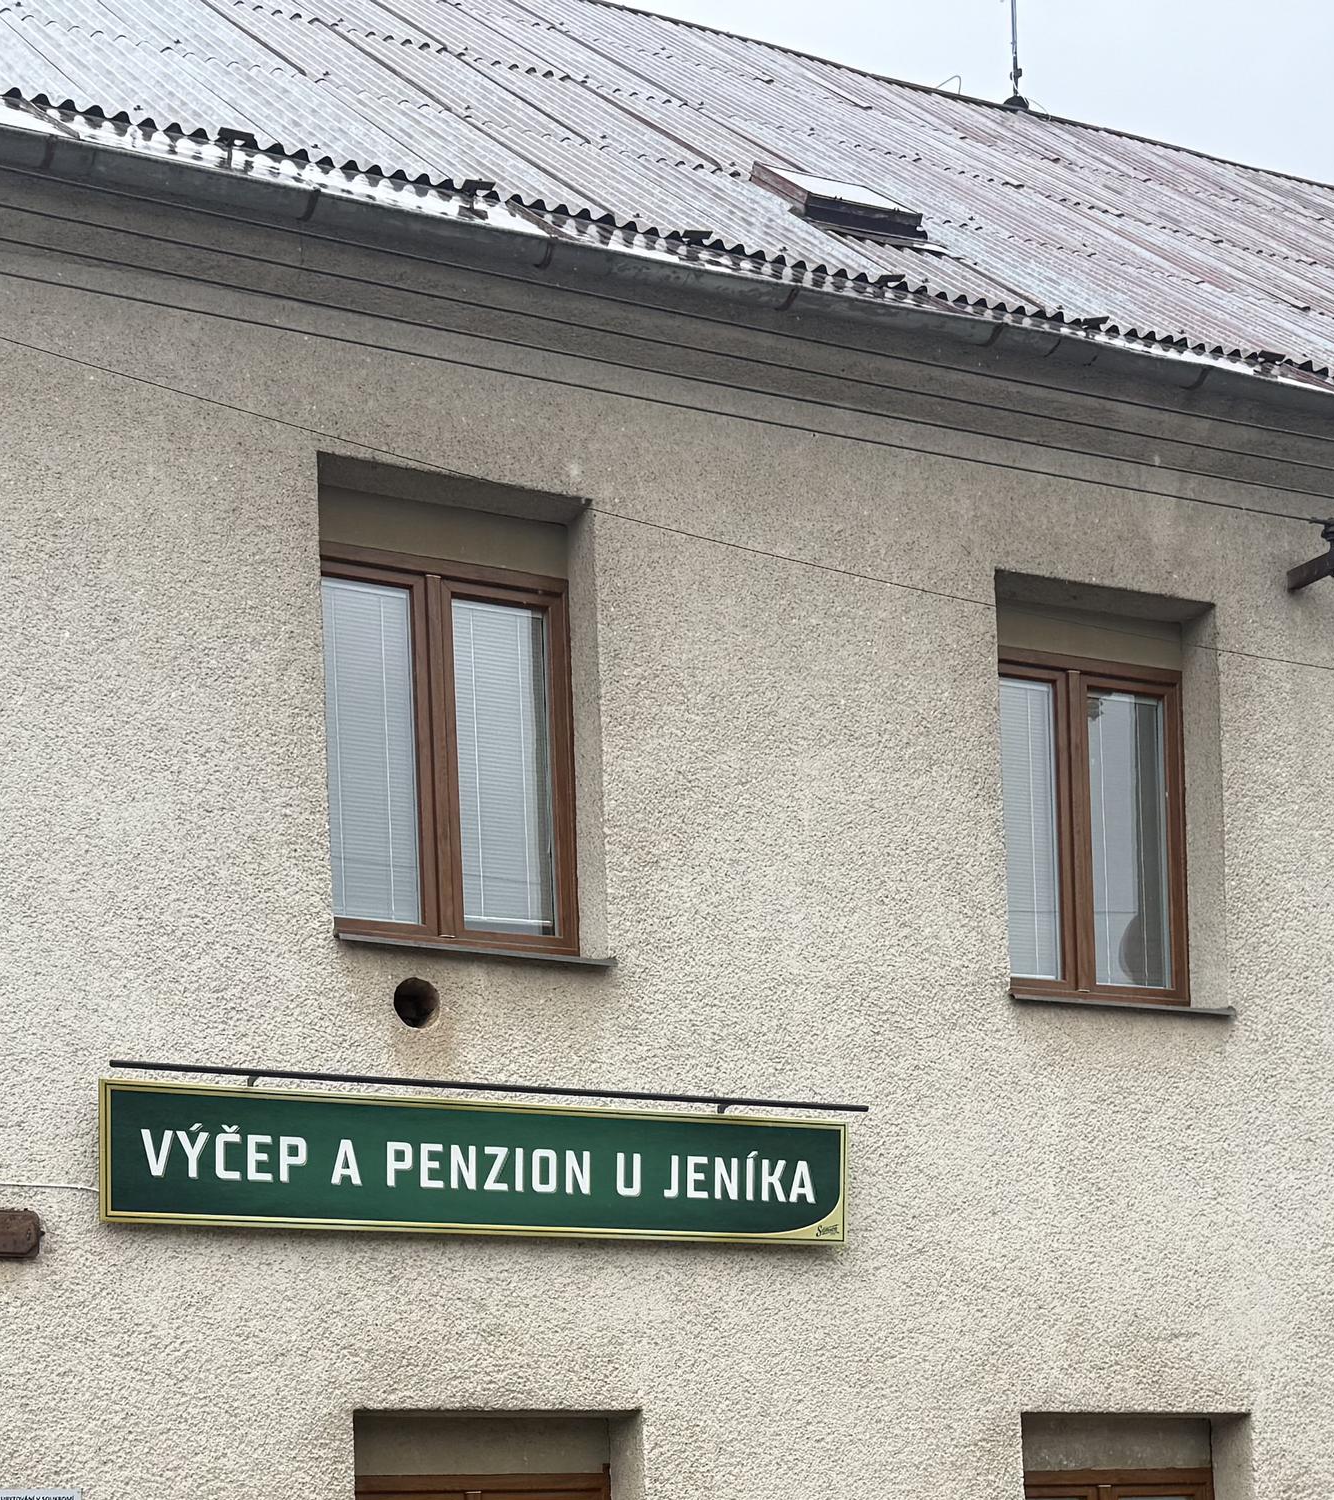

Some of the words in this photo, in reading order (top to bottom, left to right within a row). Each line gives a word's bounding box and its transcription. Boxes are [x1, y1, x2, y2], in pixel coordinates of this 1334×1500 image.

[140, 1123, 308, 1184] VÝČEP
[330, 1138, 364, 1188] A
[385, 1140, 592, 1196] PENZION
[615, 1151, 643, 1198] U
[663, 1150, 817, 1205] JENÍKA
